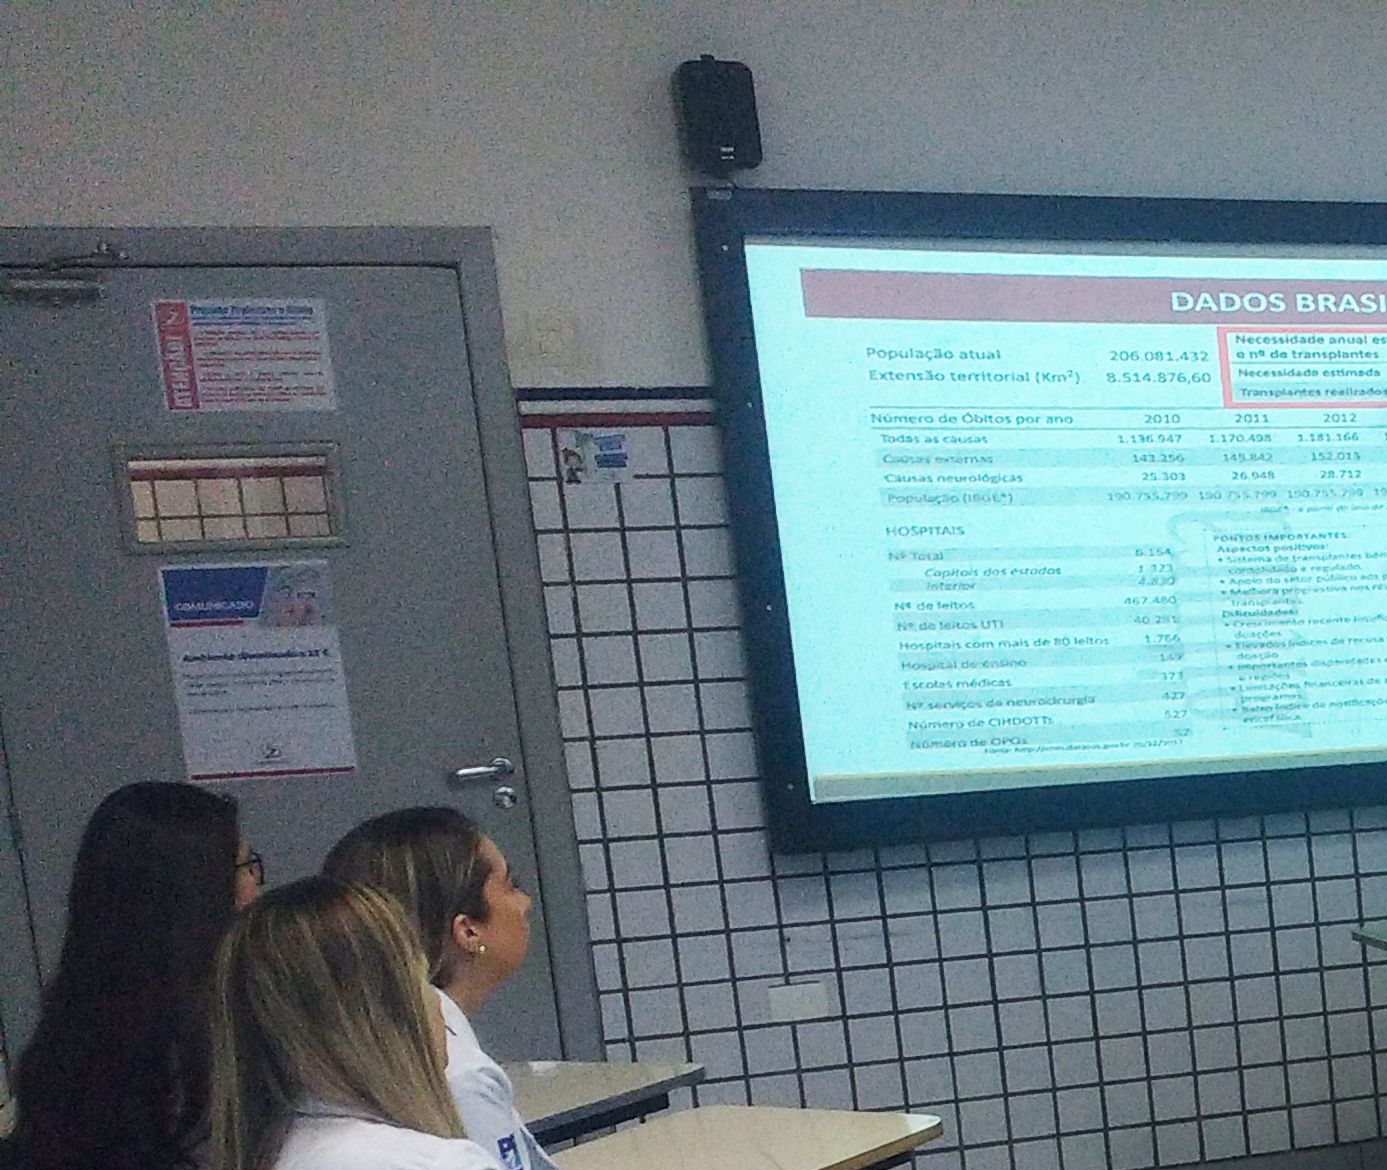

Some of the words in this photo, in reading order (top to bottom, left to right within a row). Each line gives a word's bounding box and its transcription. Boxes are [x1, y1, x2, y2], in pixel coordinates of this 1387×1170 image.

[1171, 292, 1286, 313] DADOS
[1235, 334, 1325, 345] Necessidade
[1328, 334, 1367, 345] anual
[866, 347, 954, 362] População
[958, 348, 1001, 361] atual
[1109, 350, 1210, 362] 206.081.432
[1236, 350, 1244, 359] e
[1269, 349, 1287, 359] de
[1291, 349, 1379, 362] transplantes
[868, 369, 945, 383] Extensão
[950, 370, 1030, 383] territorial
[1035, 368, 1081, 386] (Km²)
[1106, 371, 1212, 386] 8.514.876,60
[1238, 367, 1319, 378] Necessidade
[1322, 367, 1381, 378] estimada
[1239, 387, 1322, 398] Transplantes
[871, 411, 934, 425] Número
[938, 412, 958, 425] de
[961, 411, 1012, 425] Óbitos
[1016, 415, 1041, 428] por
[1045, 415, 1074, 425] ano
[1144, 413, 1181, 425] 2010
[1234, 413, 1270, 424] 2011
[1322, 413, 1358, 423] 2012
[880, 433, 920, 445] Todas
[923, 436, 939, 445] as
[942, 436, 989, 445] causas
[882, 453, 931, 465] Causas
[934, 454, 994, 465] externas
[884, 472, 933, 484] Causas
[936, 472, 1024, 485] neurológicas
[887, 491, 961, 505] População
[885, 525, 966, 537] HOSPITAIS
[910, 550, 945, 561] Total
[924, 566, 979, 579] Capitais
[982, 566, 1008, 577] dos
[1010, 565, 1062, 577] estados
[917, 600, 934, 611] de
[936, 599, 976, 611] leitos
[899, 639, 963, 652] Hospitais
[965, 640, 994, 650] com
[998, 638, 1030, 649] mais
[1033, 637, 1051, 648] de
[1074, 635, 1110, 647] leitos
[901, 660, 958, 672] Hospital
[956, 677, 1012, 689] médicas
[909, 718, 964, 731] Número
[968, 718, 985, 729] de
[910, 738, 966, 750] Número
